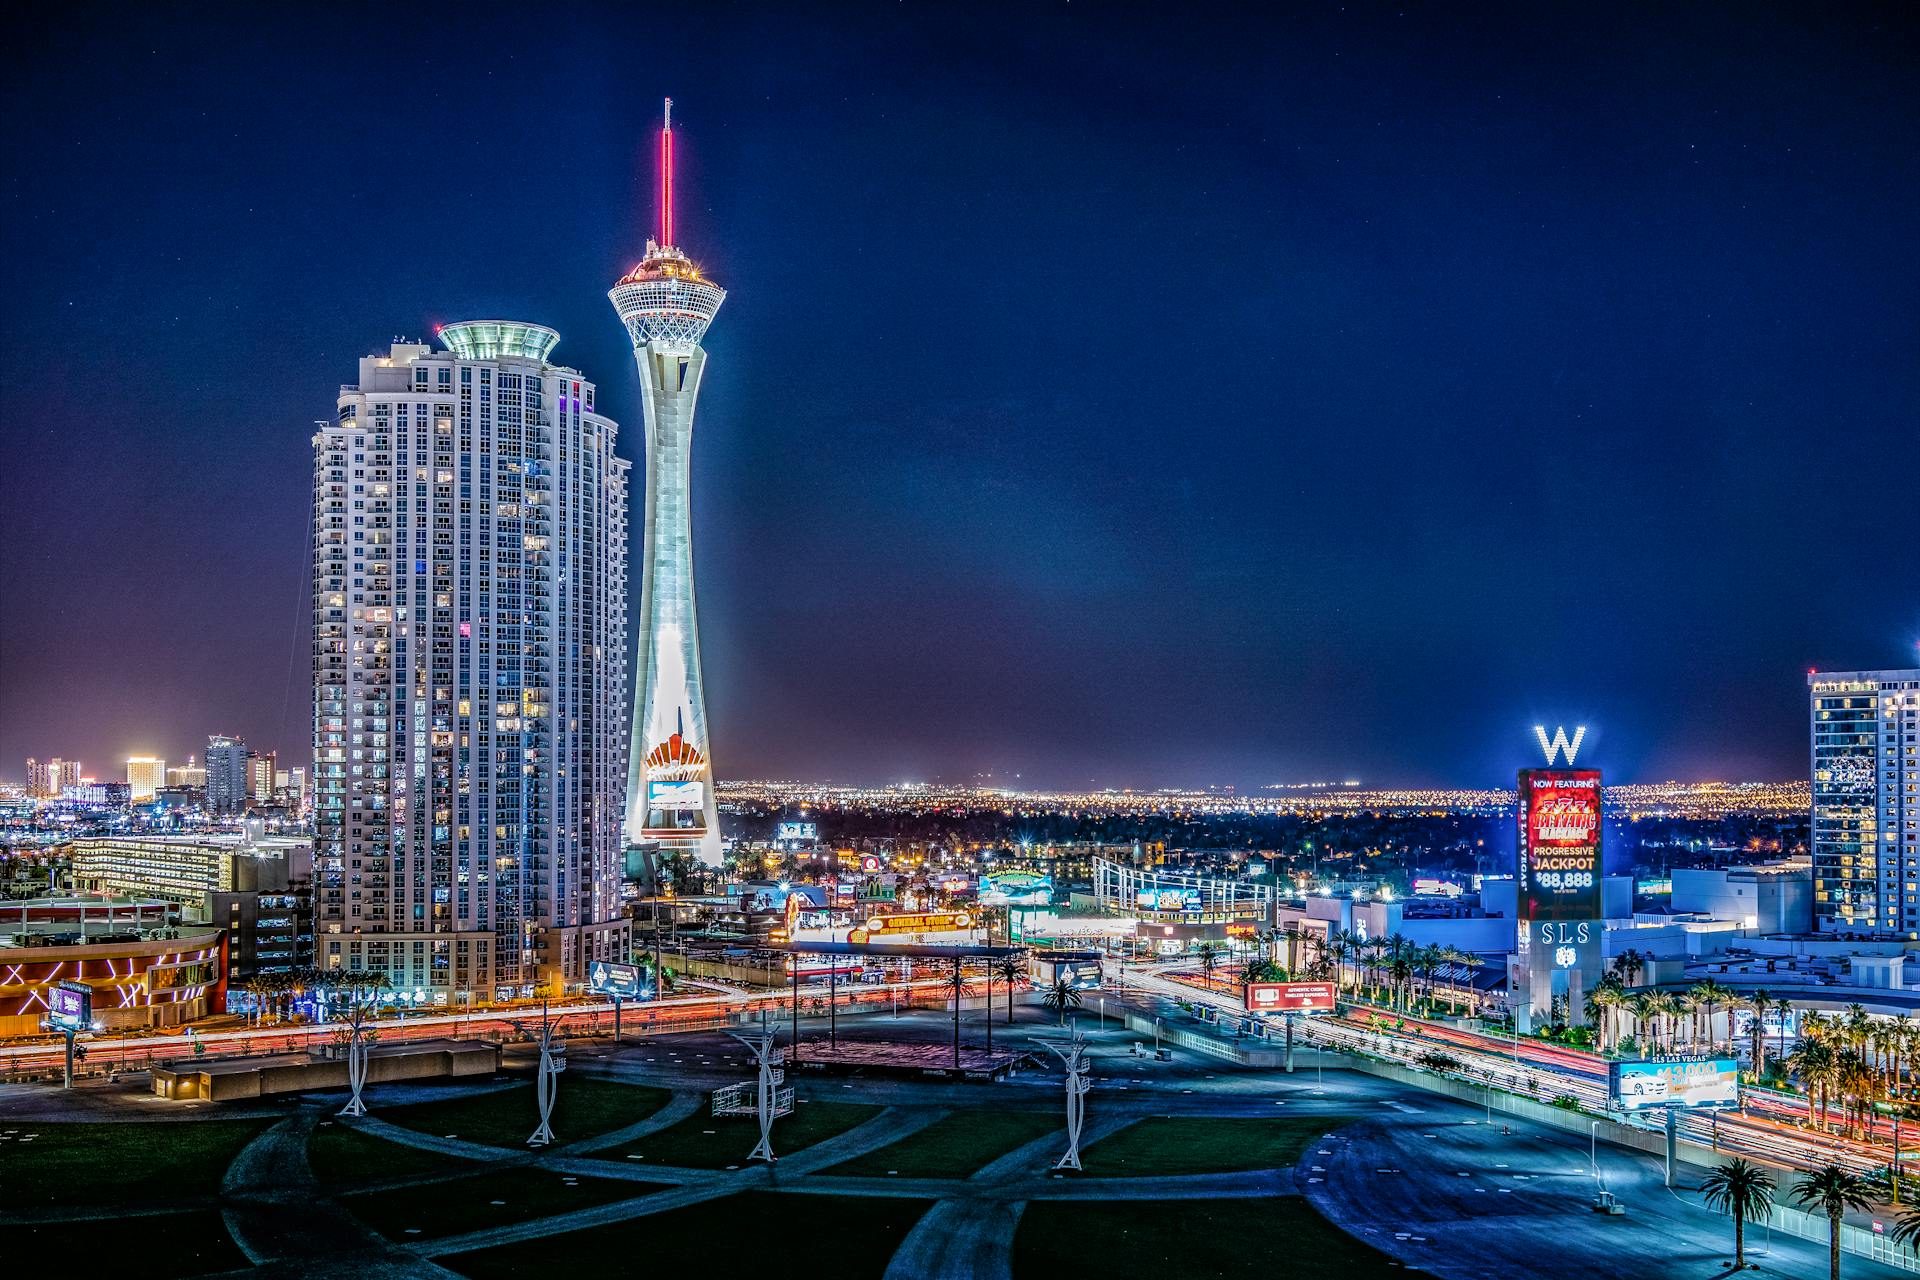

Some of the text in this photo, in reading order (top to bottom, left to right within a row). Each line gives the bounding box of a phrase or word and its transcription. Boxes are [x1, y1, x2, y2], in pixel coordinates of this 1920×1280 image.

[1535, 725, 1586, 766] W
[1533, 780, 1594, 788] NOW FEATURING
[1533, 847, 1595, 855] PROGRESSIVE
[1533, 857, 1595, 870] JACKPOT
[1536, 872, 1593, 889] $88,888
[1541, 922, 1590, 944] SLS
